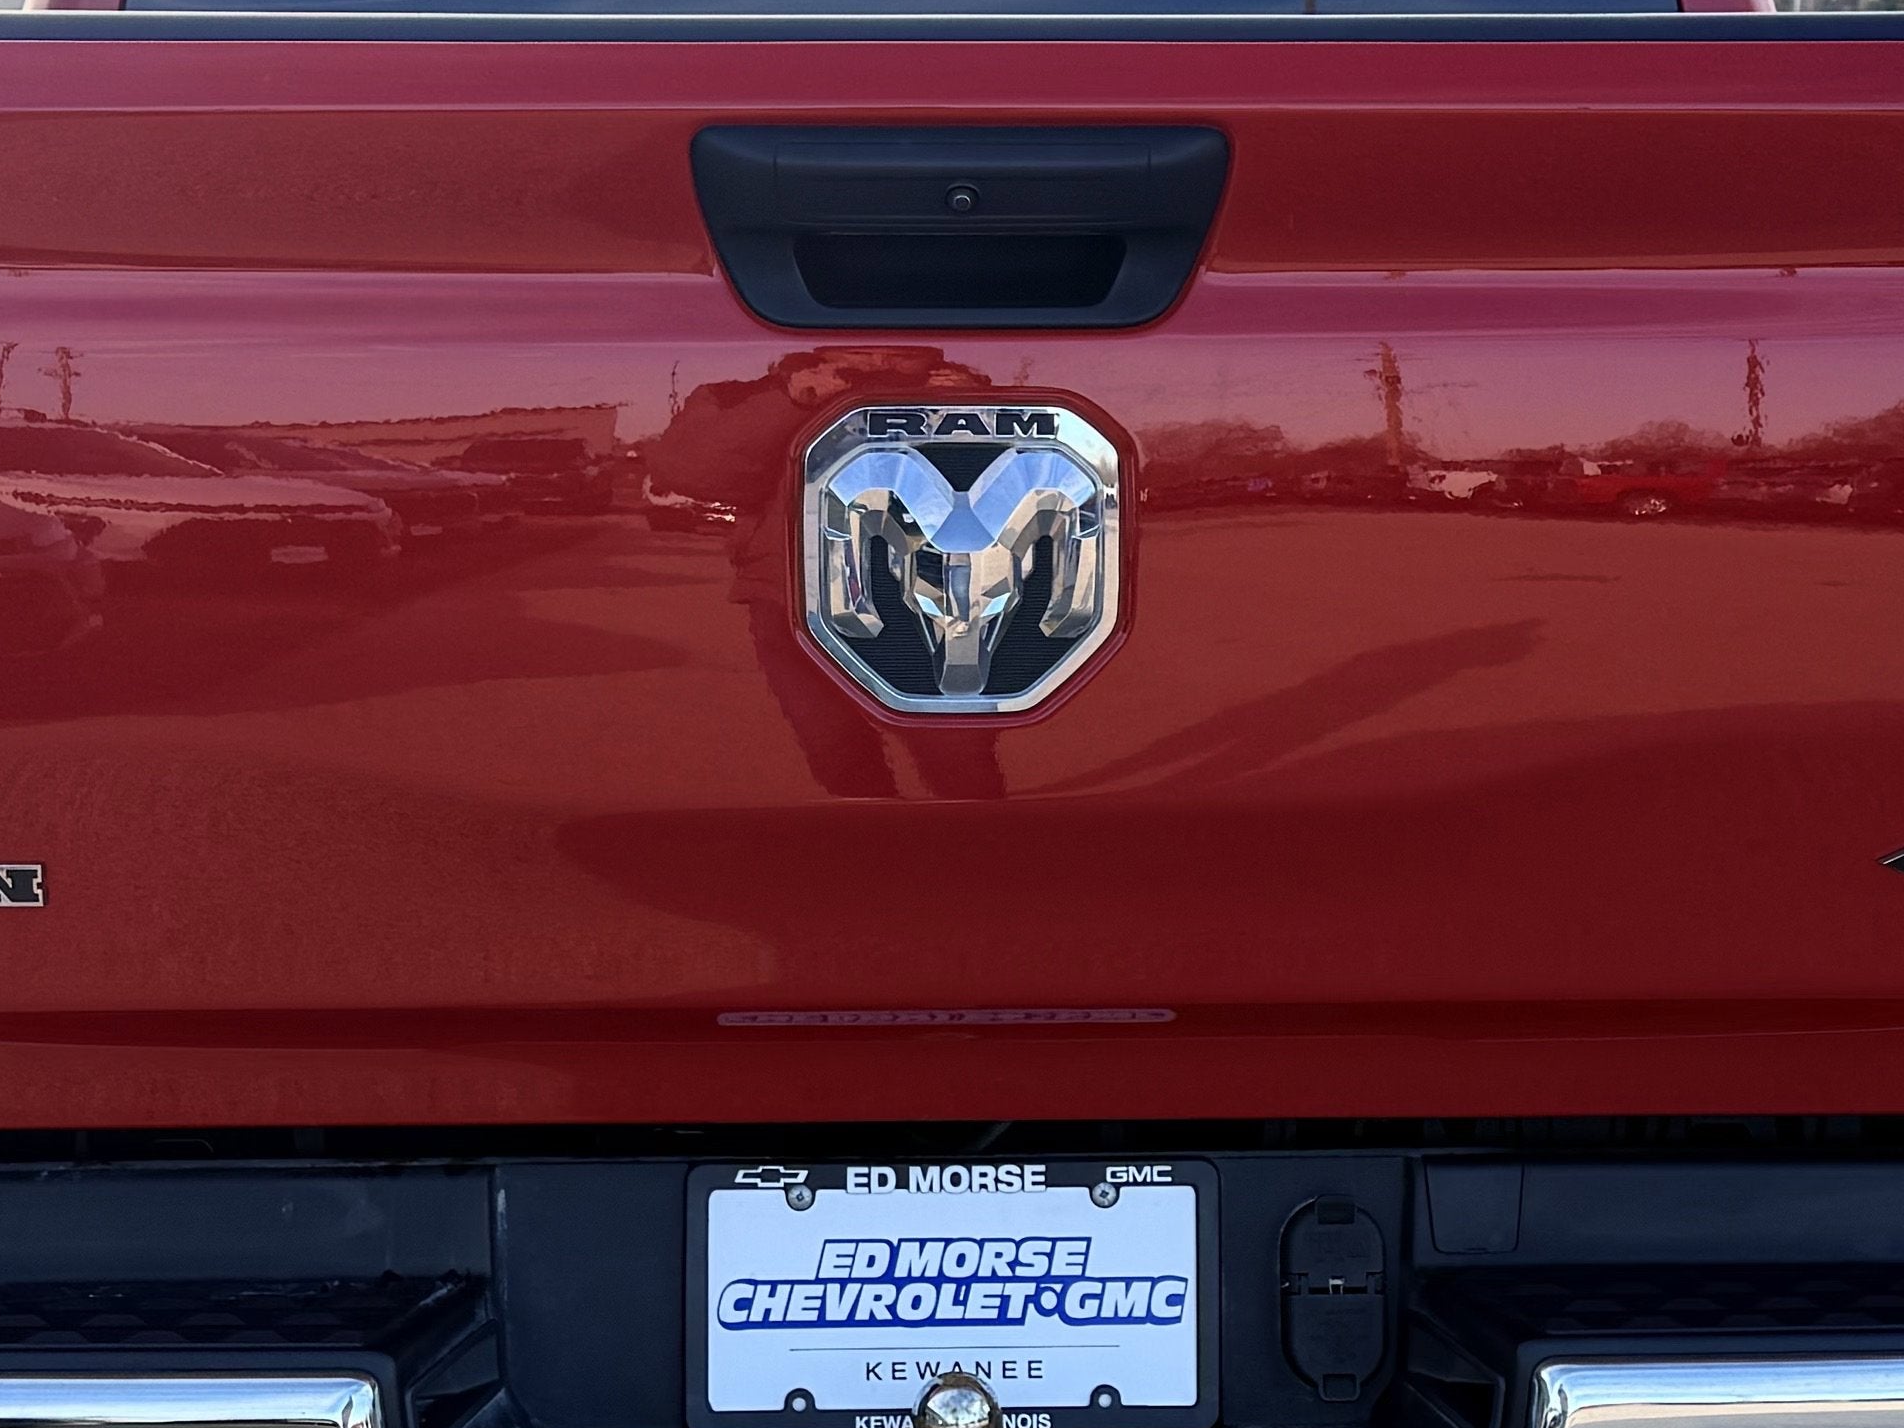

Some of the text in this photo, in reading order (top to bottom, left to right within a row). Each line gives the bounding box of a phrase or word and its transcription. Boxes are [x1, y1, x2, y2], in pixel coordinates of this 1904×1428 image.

[867, 410, 1058, 437] RAM
[845, 1164, 1047, 1194] ED MORSE
[1105, 1165, 1173, 1184] GMC
[815, 1237, 1092, 1280] ED MORSE
